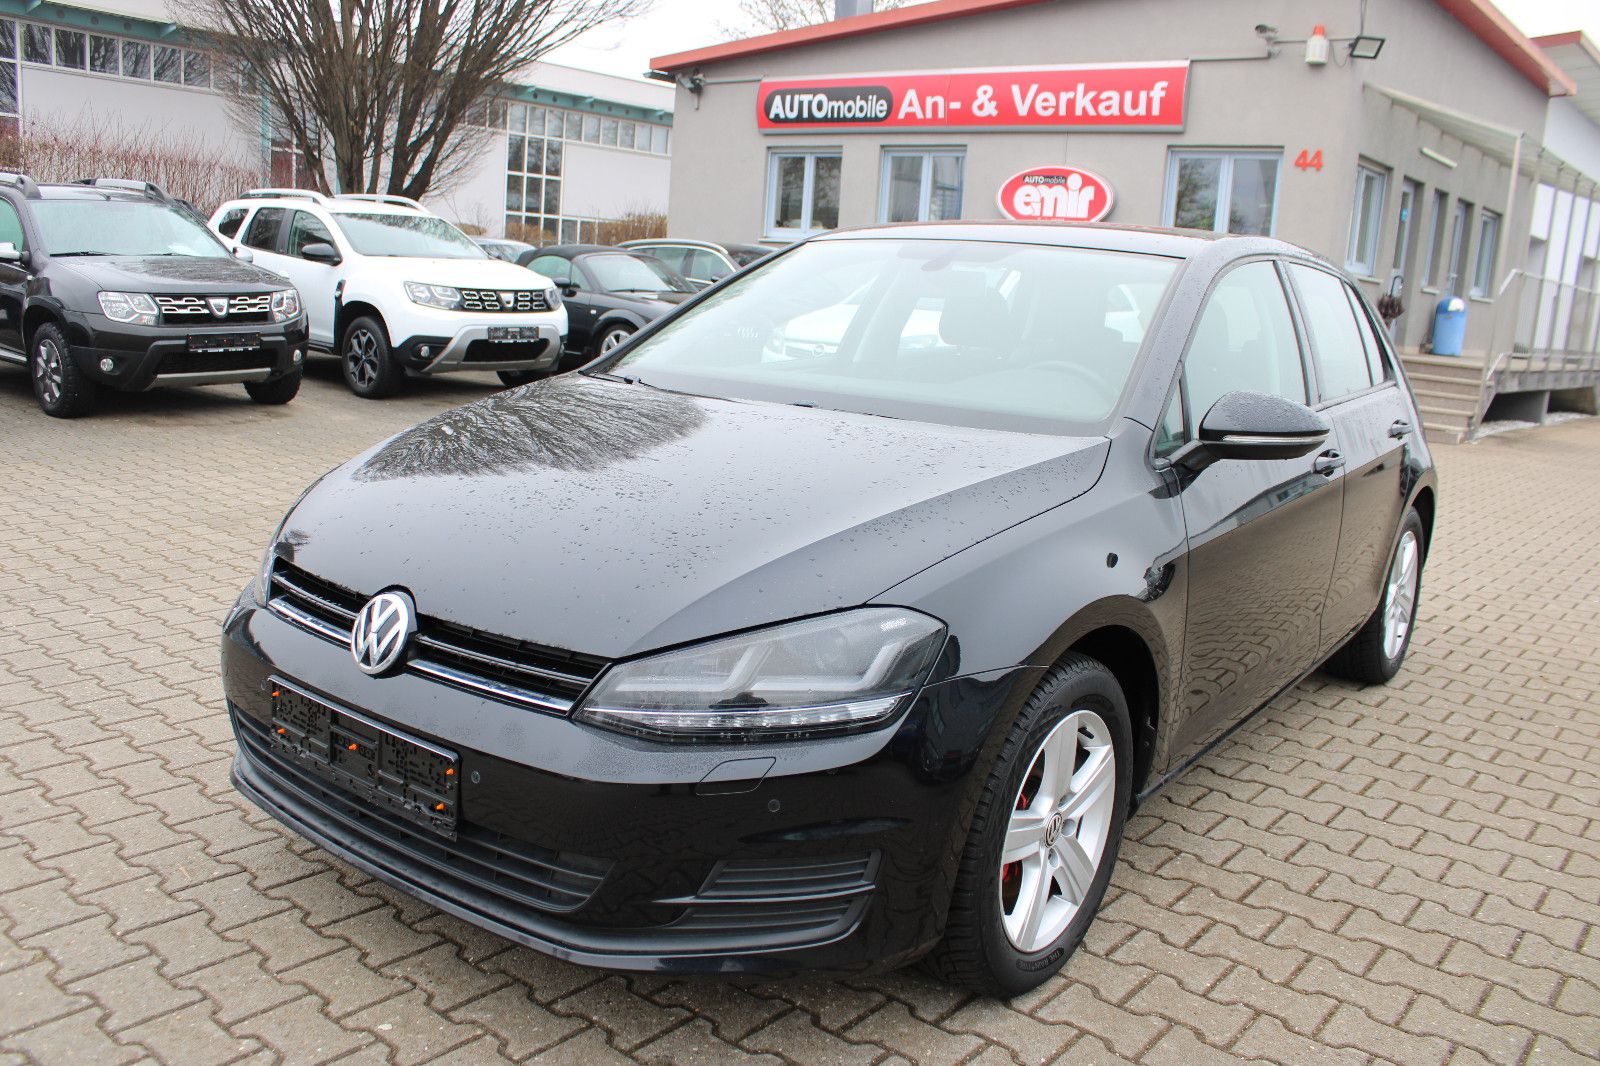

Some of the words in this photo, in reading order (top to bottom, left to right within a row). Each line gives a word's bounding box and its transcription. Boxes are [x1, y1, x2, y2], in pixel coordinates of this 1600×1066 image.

[769, 93, 888, 120] AUTOmobile
[897, 88, 961, 120] An-
[971, 84, 999, 117] &
[1011, 80, 1169, 117] Verkauf
[1295, 149, 1323, 171] 44
[1013, 173, 1095, 219] emir
[1024, 176, 1066, 185] AUTOmobile
